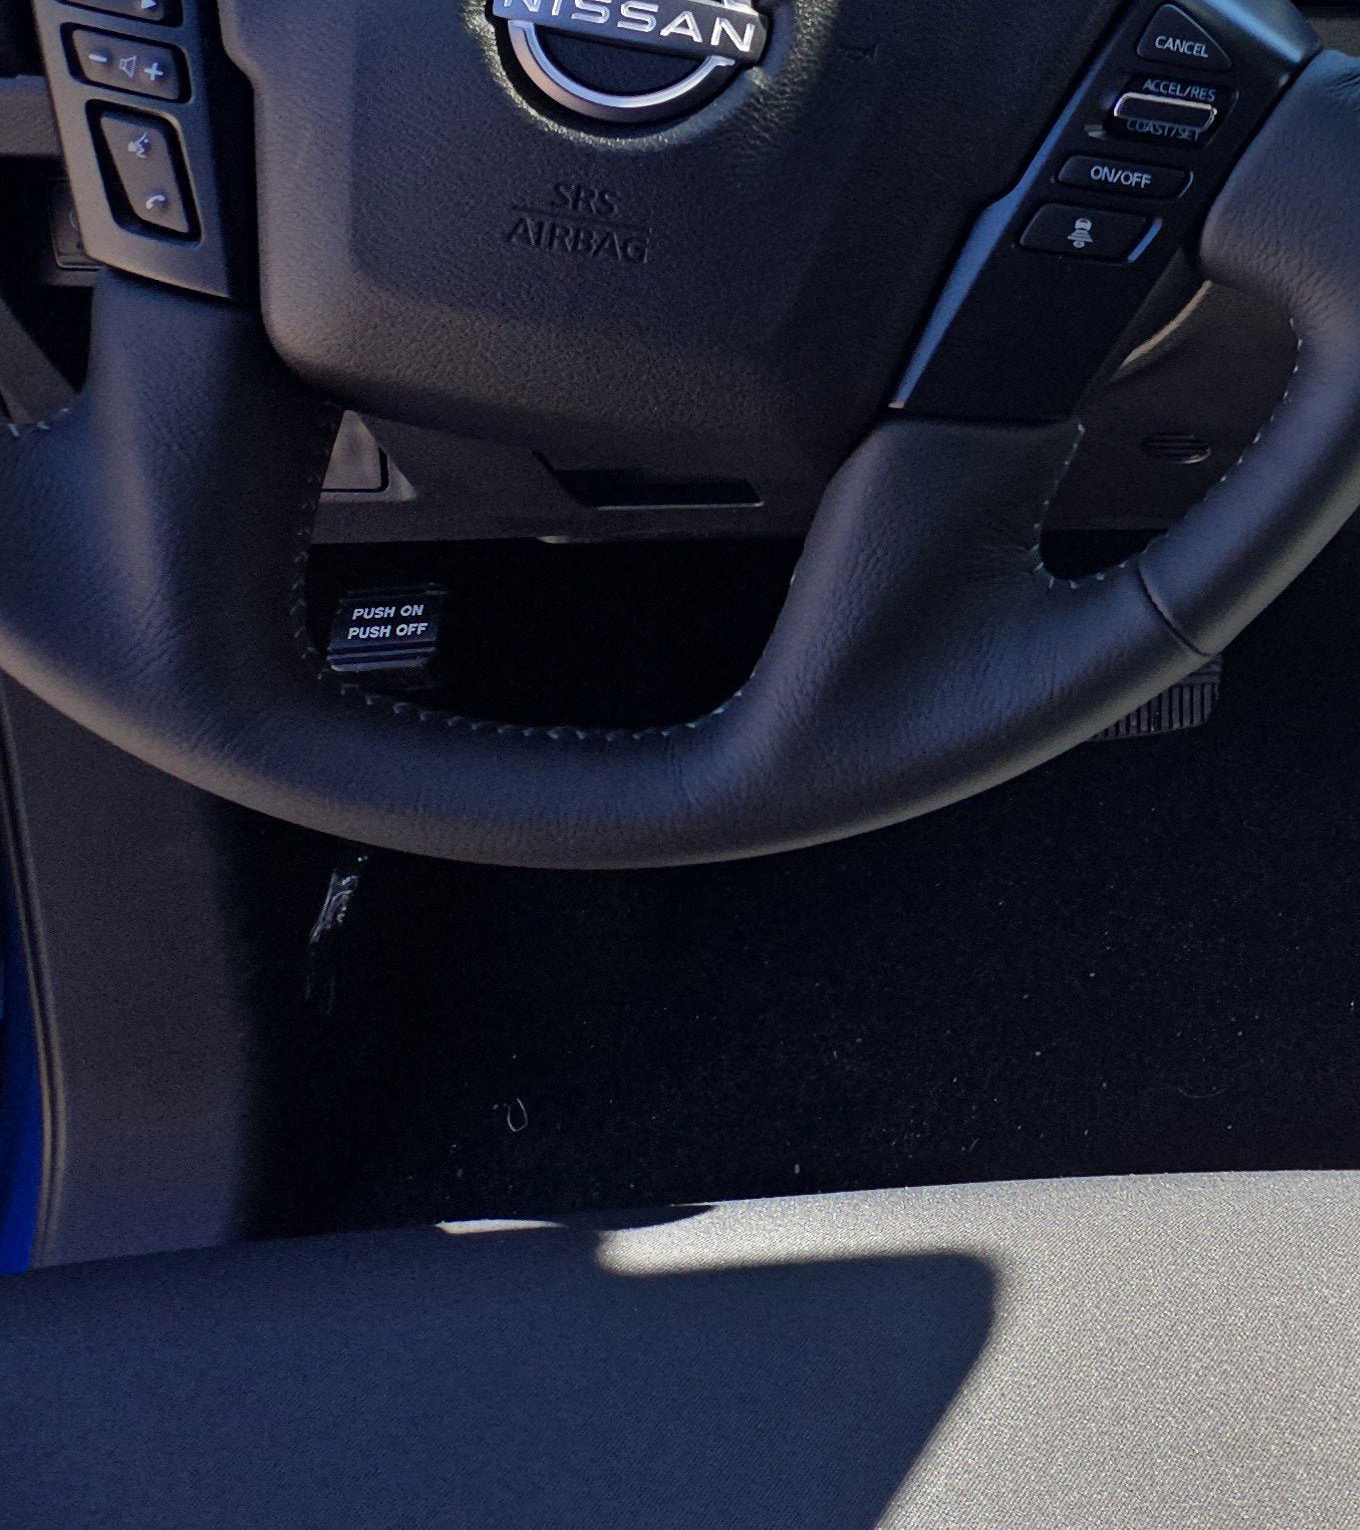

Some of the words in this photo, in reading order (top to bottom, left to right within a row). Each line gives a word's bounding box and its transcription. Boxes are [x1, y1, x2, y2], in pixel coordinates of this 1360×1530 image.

[1155, 35, 1209, 58] CANCEL
[1142, 79, 1217, 101] ACCEL/RES
[1127, 120, 1200, 141] COAST/SET
[1090, 165, 1152, 189] ON/OFF
[554, 182, 619, 216] SRS
[506, 217, 653, 263] AIRBAG
[352, 606, 396, 620] PUSH
[400, 604, 424, 617] ON
[347, 625, 392, 639] PUSH
[395, 622, 429, 636] OFF
